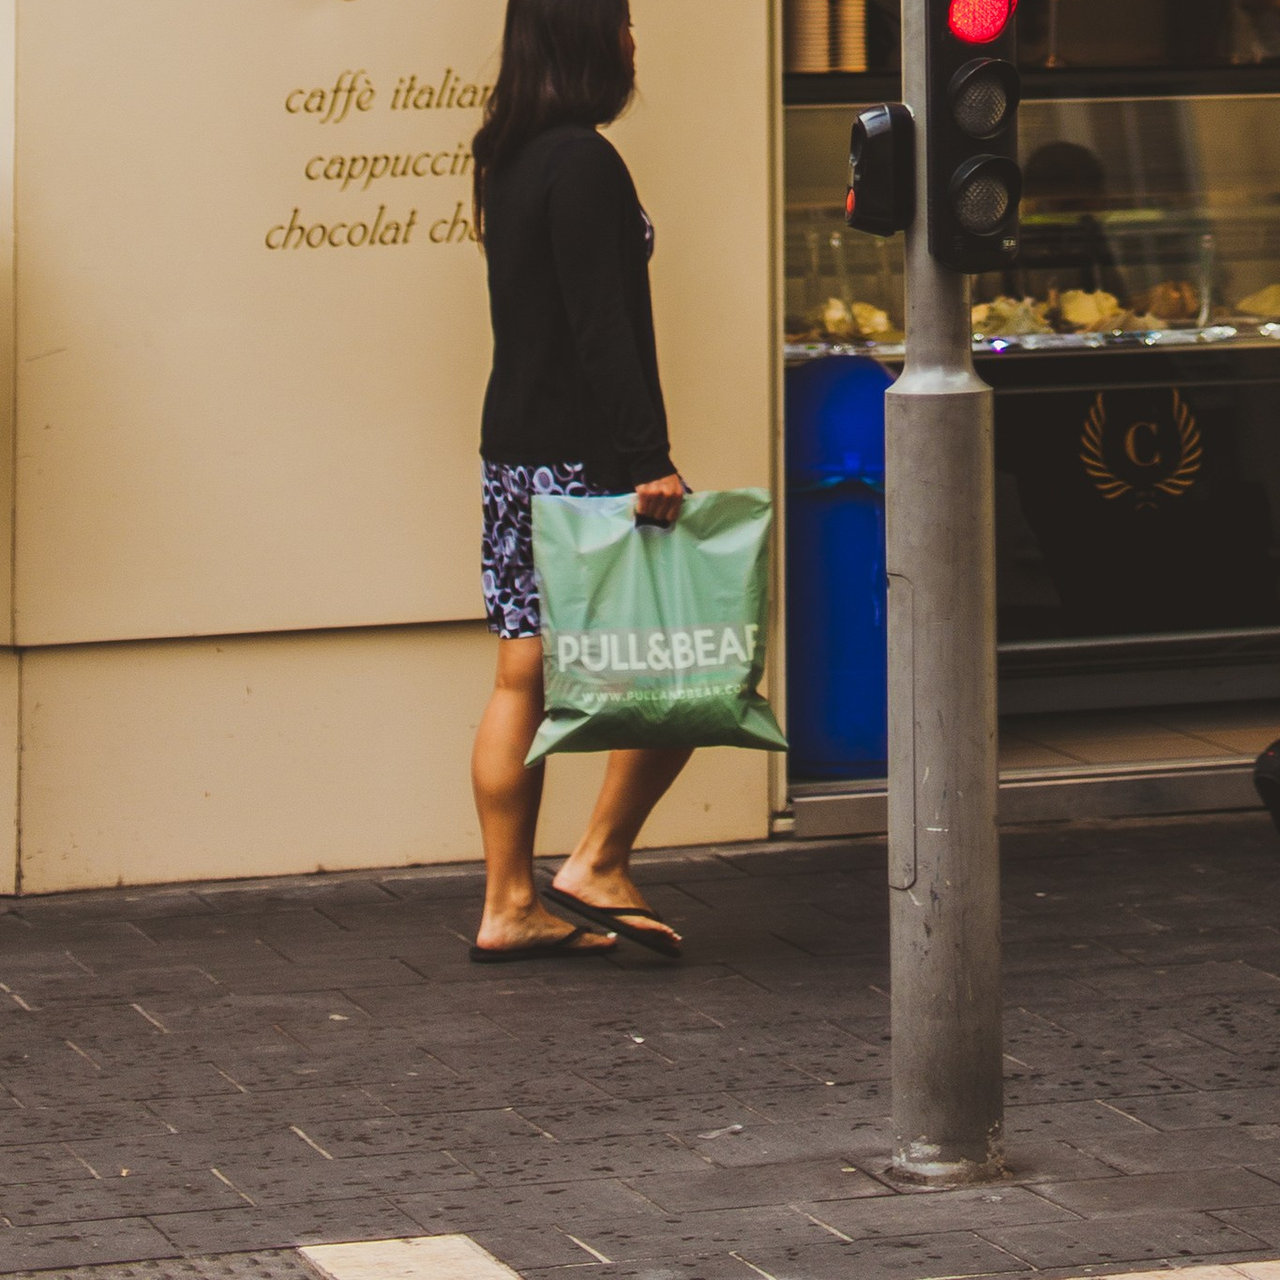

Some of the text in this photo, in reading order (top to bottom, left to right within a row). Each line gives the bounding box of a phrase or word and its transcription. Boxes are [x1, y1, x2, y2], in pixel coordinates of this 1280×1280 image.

[285, 68, 376, 124] caffè
[265, 204, 418, 250] chocolat
[1124, 421, 1162, 467] C
[581, 683, 747, 704] WWW.PULLANDBEAR.CO
